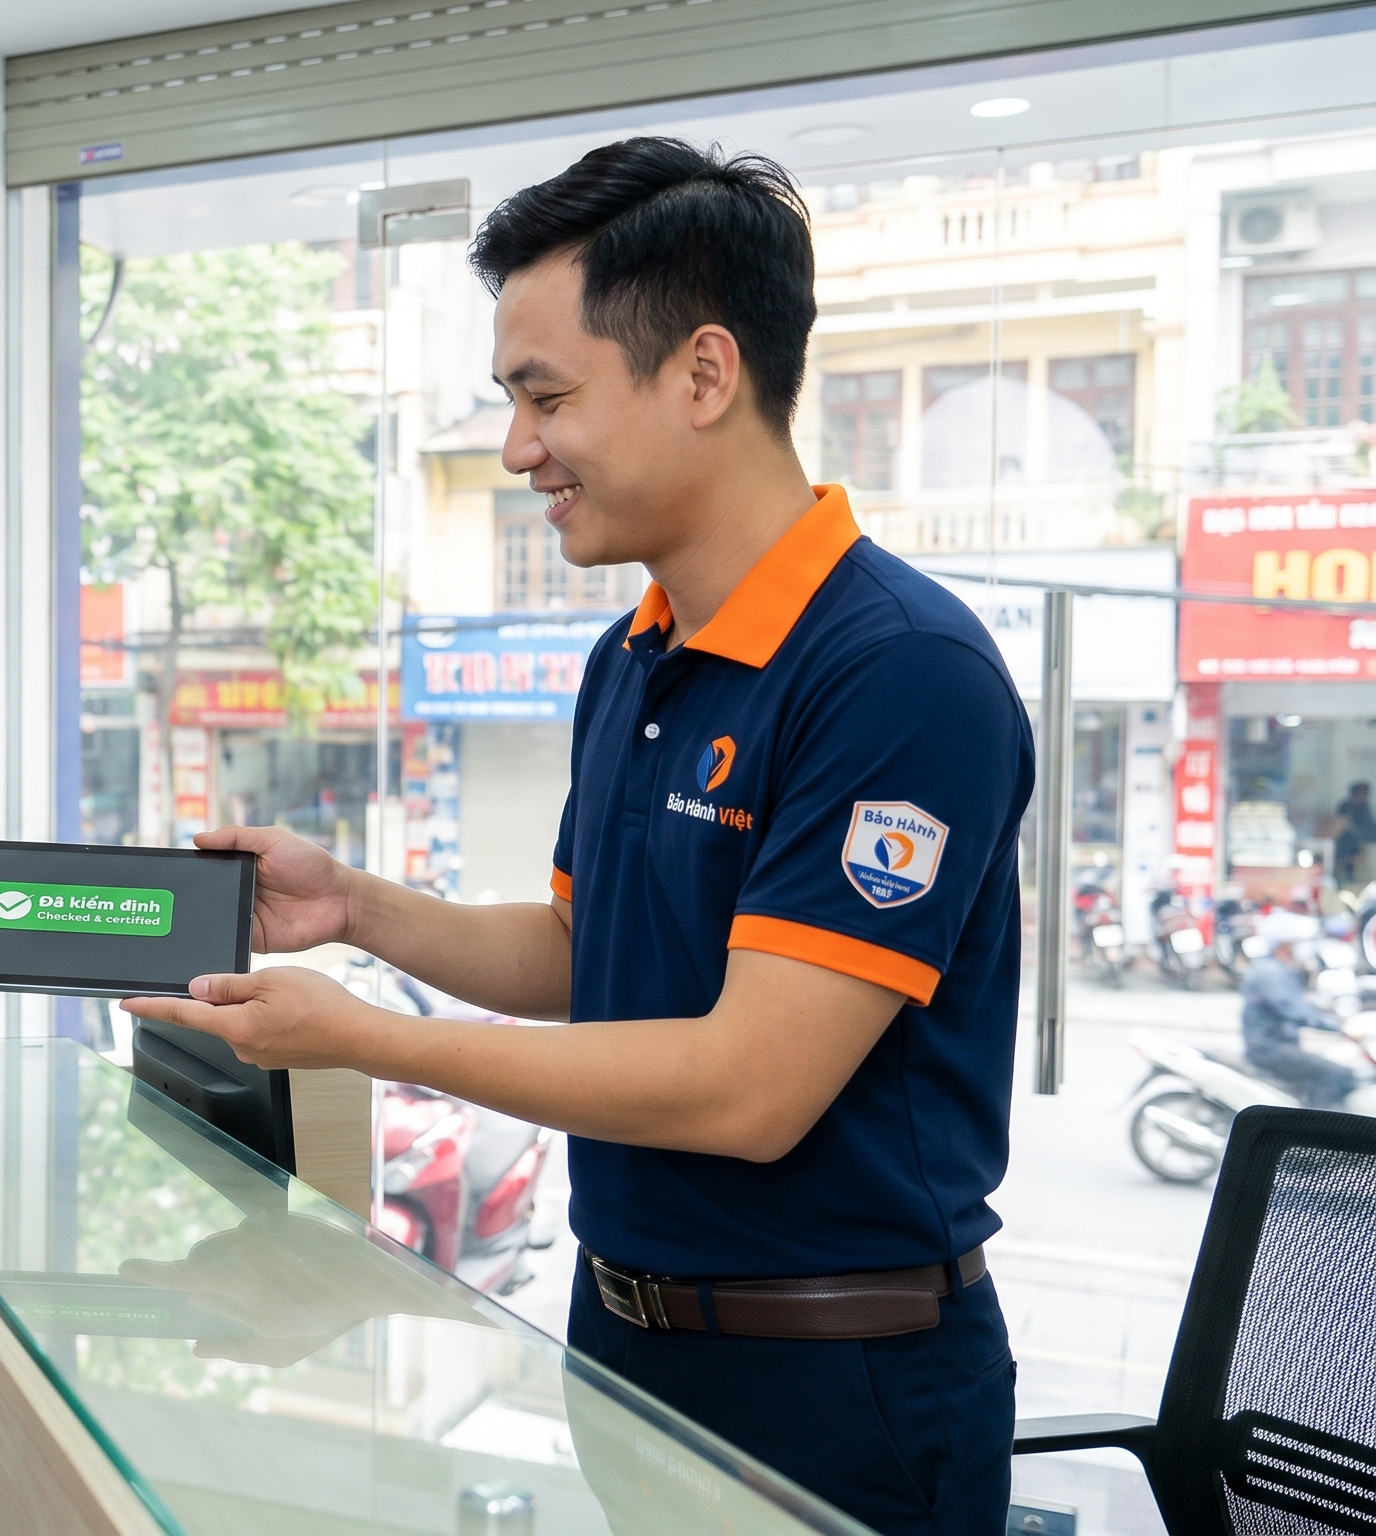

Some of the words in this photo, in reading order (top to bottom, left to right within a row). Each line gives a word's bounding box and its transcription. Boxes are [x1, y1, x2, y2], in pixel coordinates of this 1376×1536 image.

[1253, 548, 1376, 614] HO
[719, 807, 753, 831] Việt
[36, 911, 90, 922] Checked
[93, 915, 102, 923] &
[105, 915, 160, 925] certified
